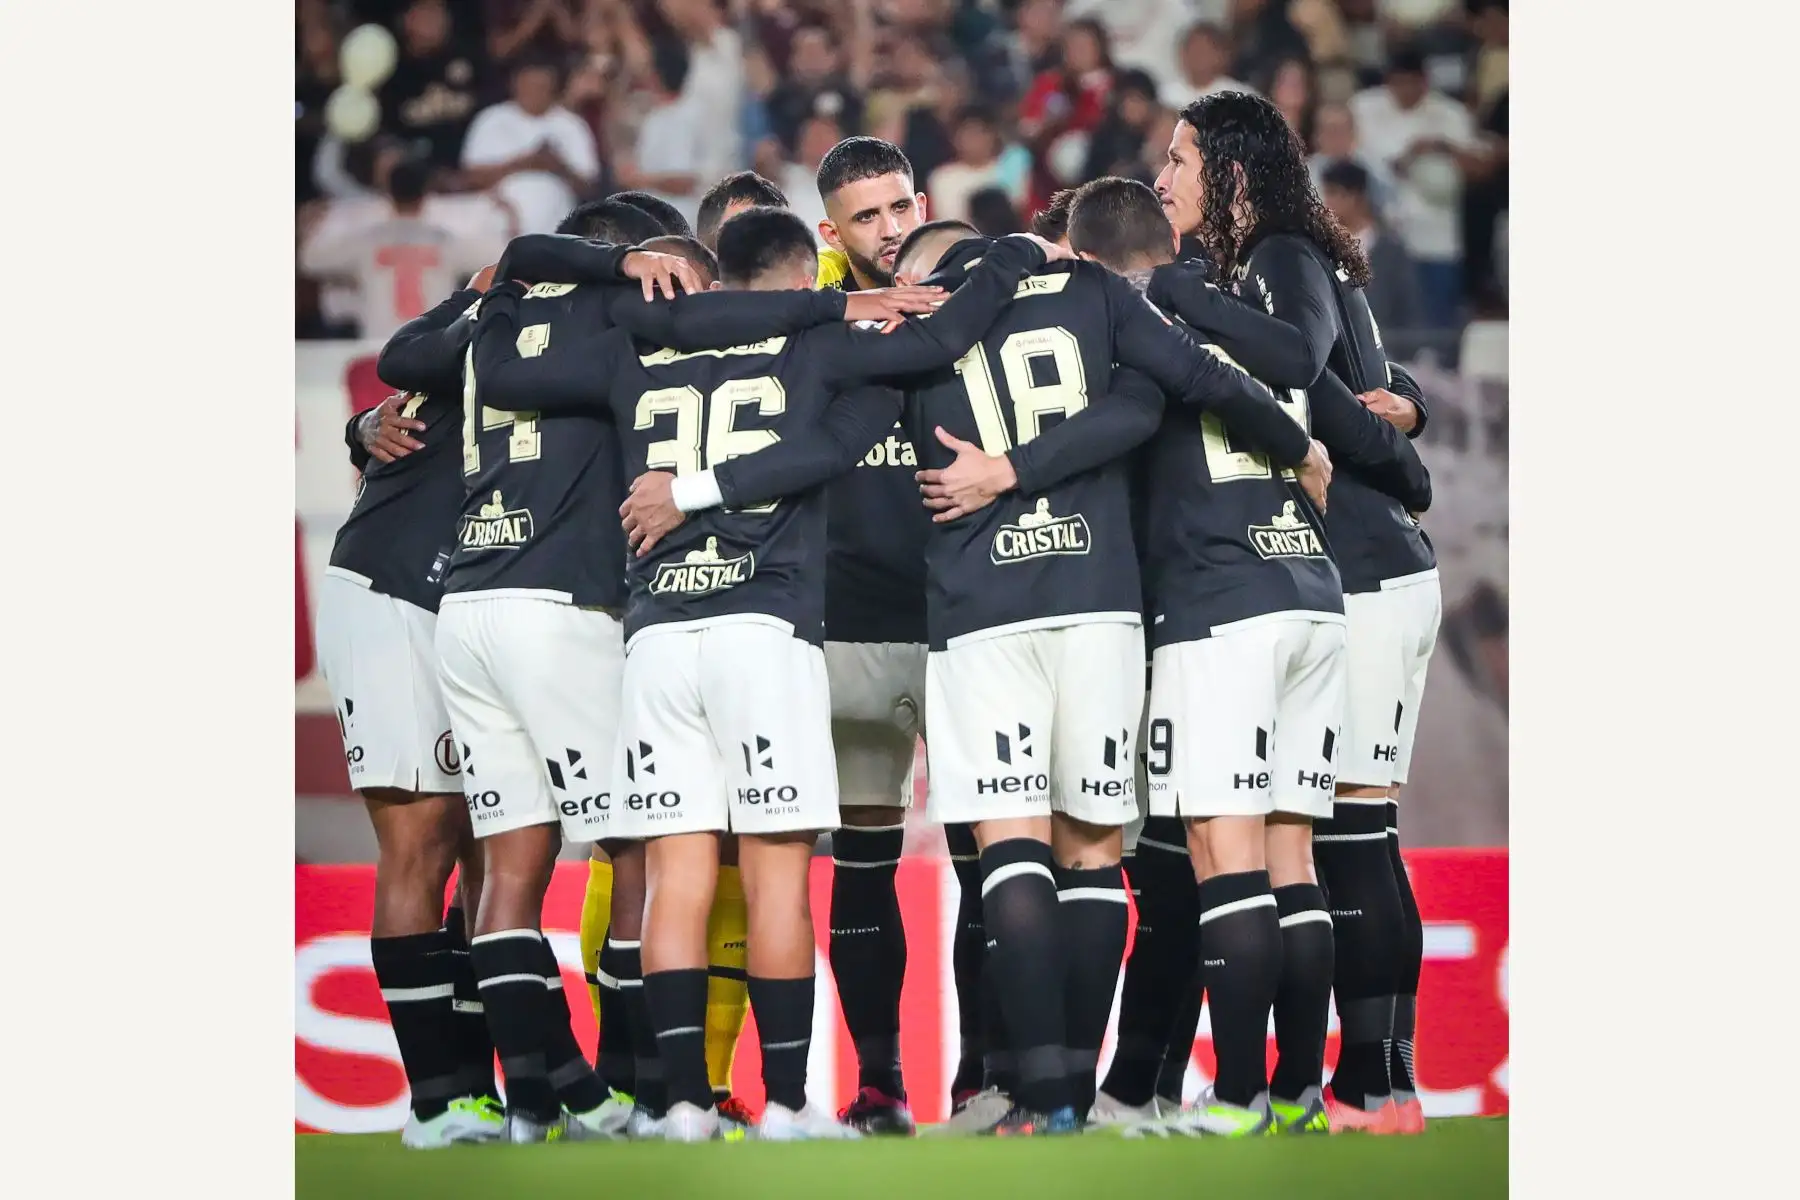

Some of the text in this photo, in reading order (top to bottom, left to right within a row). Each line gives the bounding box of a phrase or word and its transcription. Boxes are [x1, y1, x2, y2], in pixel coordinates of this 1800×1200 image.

[953, 326, 1088, 458] 18
[633, 376, 786, 514] 36
[463, 518, 527, 545] CRISTAL
[996, 523, 1084, 557] CRISTAL
[657, 562, 746, 592] CRISTAL
[1148, 718, 1173, 775] 9
[737, 785, 798, 804] Hero
[977, 774, 1047, 794] Hero
[1082, 777, 1134, 797] Hero
[647, 811, 683, 820] MOTOS
[765, 805, 800, 815] MOTOS
